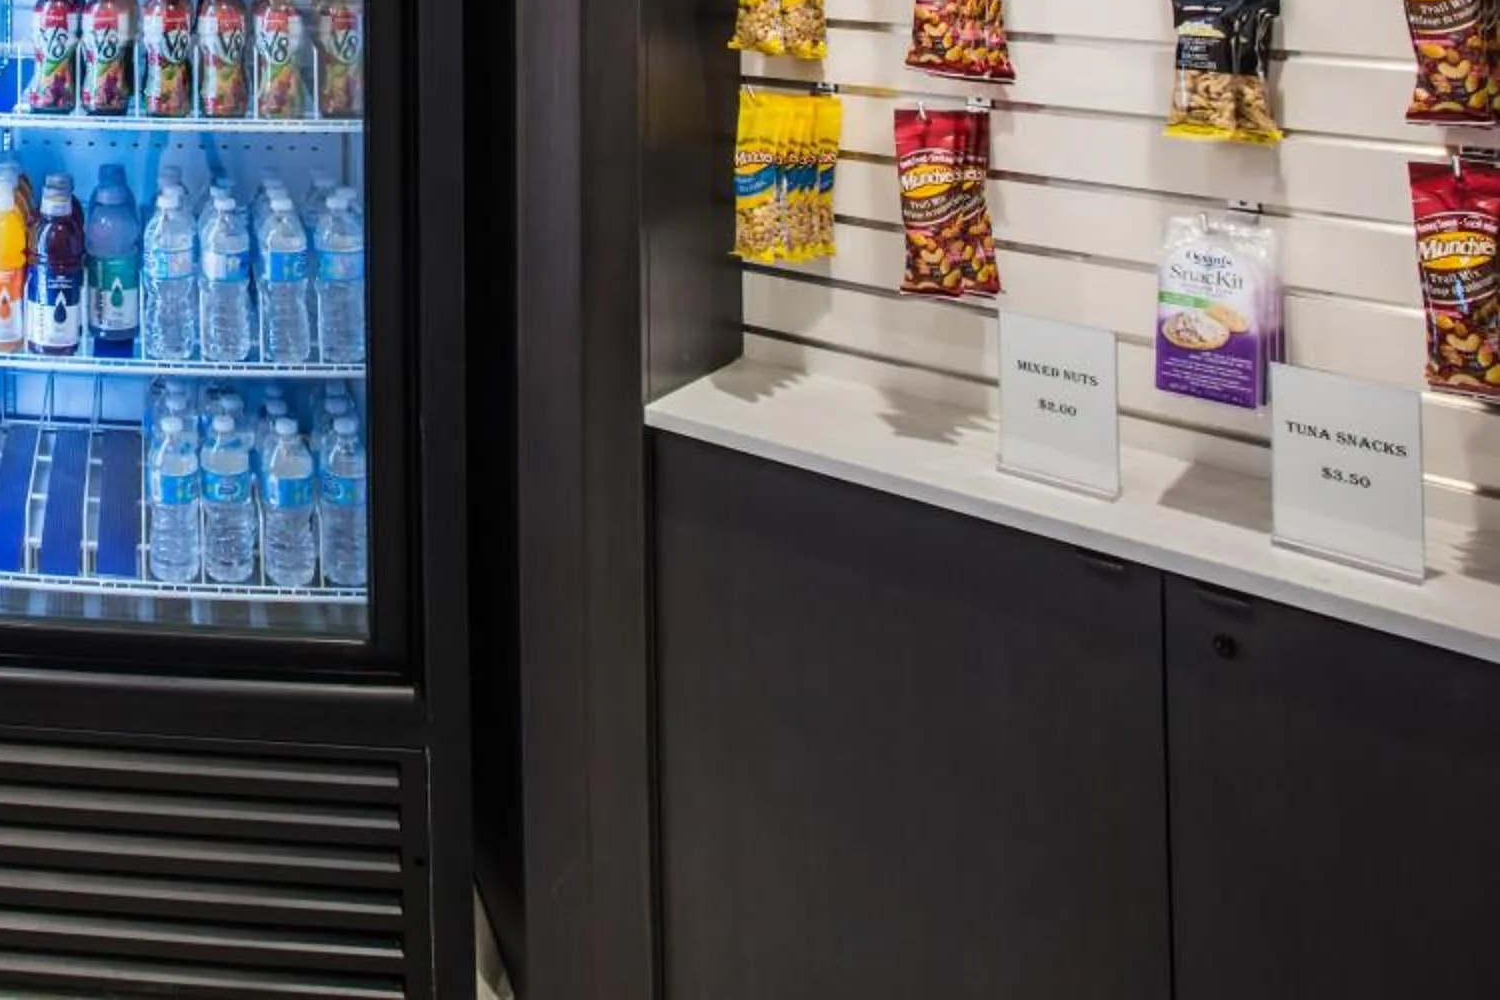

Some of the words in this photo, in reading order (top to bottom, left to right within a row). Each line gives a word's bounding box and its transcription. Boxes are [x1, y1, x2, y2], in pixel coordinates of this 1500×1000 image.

[40, 26, 69, 59] V8
[90, 27, 119, 59] V8
[163, 28, 189, 62] V8
[218, 27, 245, 62] V8
[261, 29, 290, 63] V8
[333, 30, 359, 62] V8
[1017, 359, 1060, 378] MIXED
[1063, 369, 1099, 387] NUTS
[1039, 398, 1077, 418] $2.00
[1285, 420, 1331, 441] TUNA
[1336, 431, 1408, 458] SNACKS
[1321, 466, 1372, 489] $3.50
